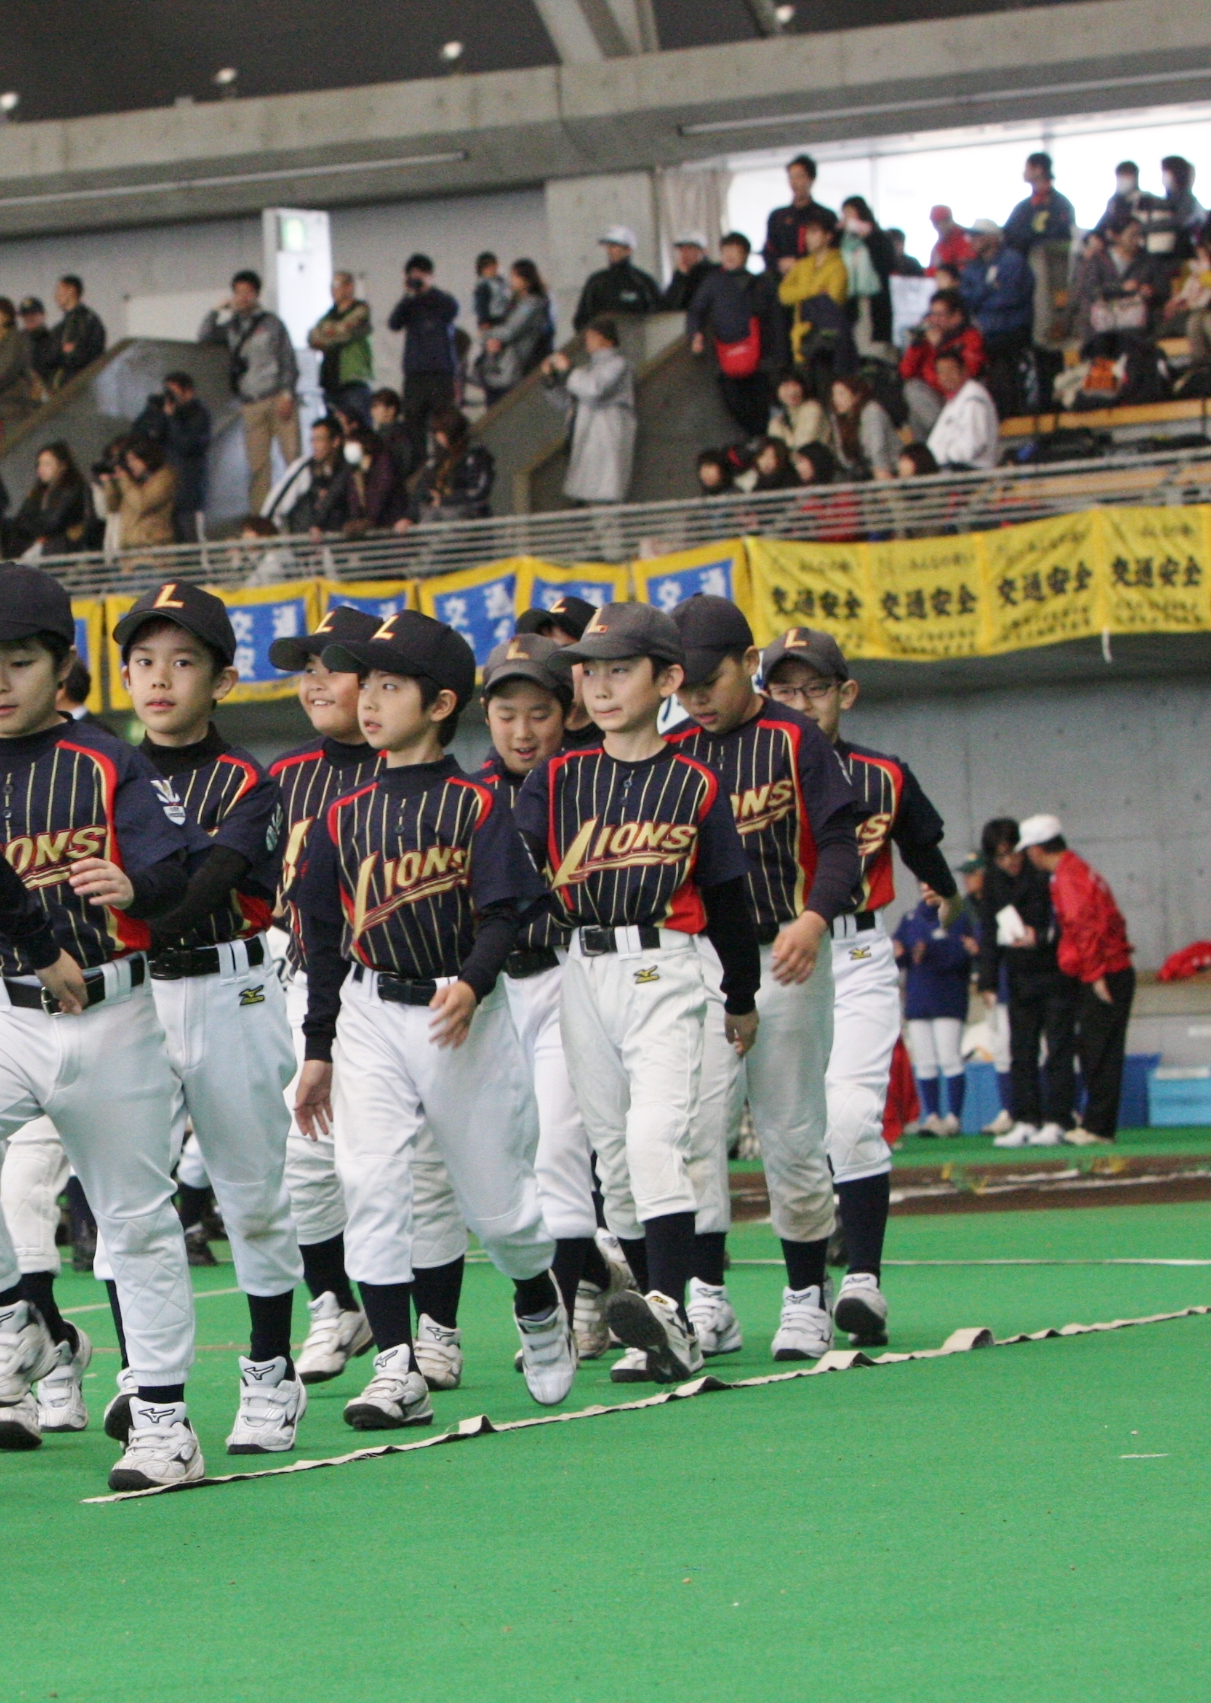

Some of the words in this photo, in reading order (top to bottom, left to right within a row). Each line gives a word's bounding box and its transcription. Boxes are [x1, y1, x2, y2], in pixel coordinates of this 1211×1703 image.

[998, 561, 1092, 606] 交通安全
[1112, 555, 1203, 589] 交通安全
[152, 583, 185, 609] L
[771, 586, 862, 619] 交通安全
[880, 582, 978, 621] 交通安全
[314, 611, 336, 634] L
[372, 613, 400, 641] L
[586, 606, 609, 634] L
[505, 635, 531, 661] L
[783, 626, 809, 649] L
[551, 814, 698, 890] LIONS
[352, 845, 470, 941] LIONS
